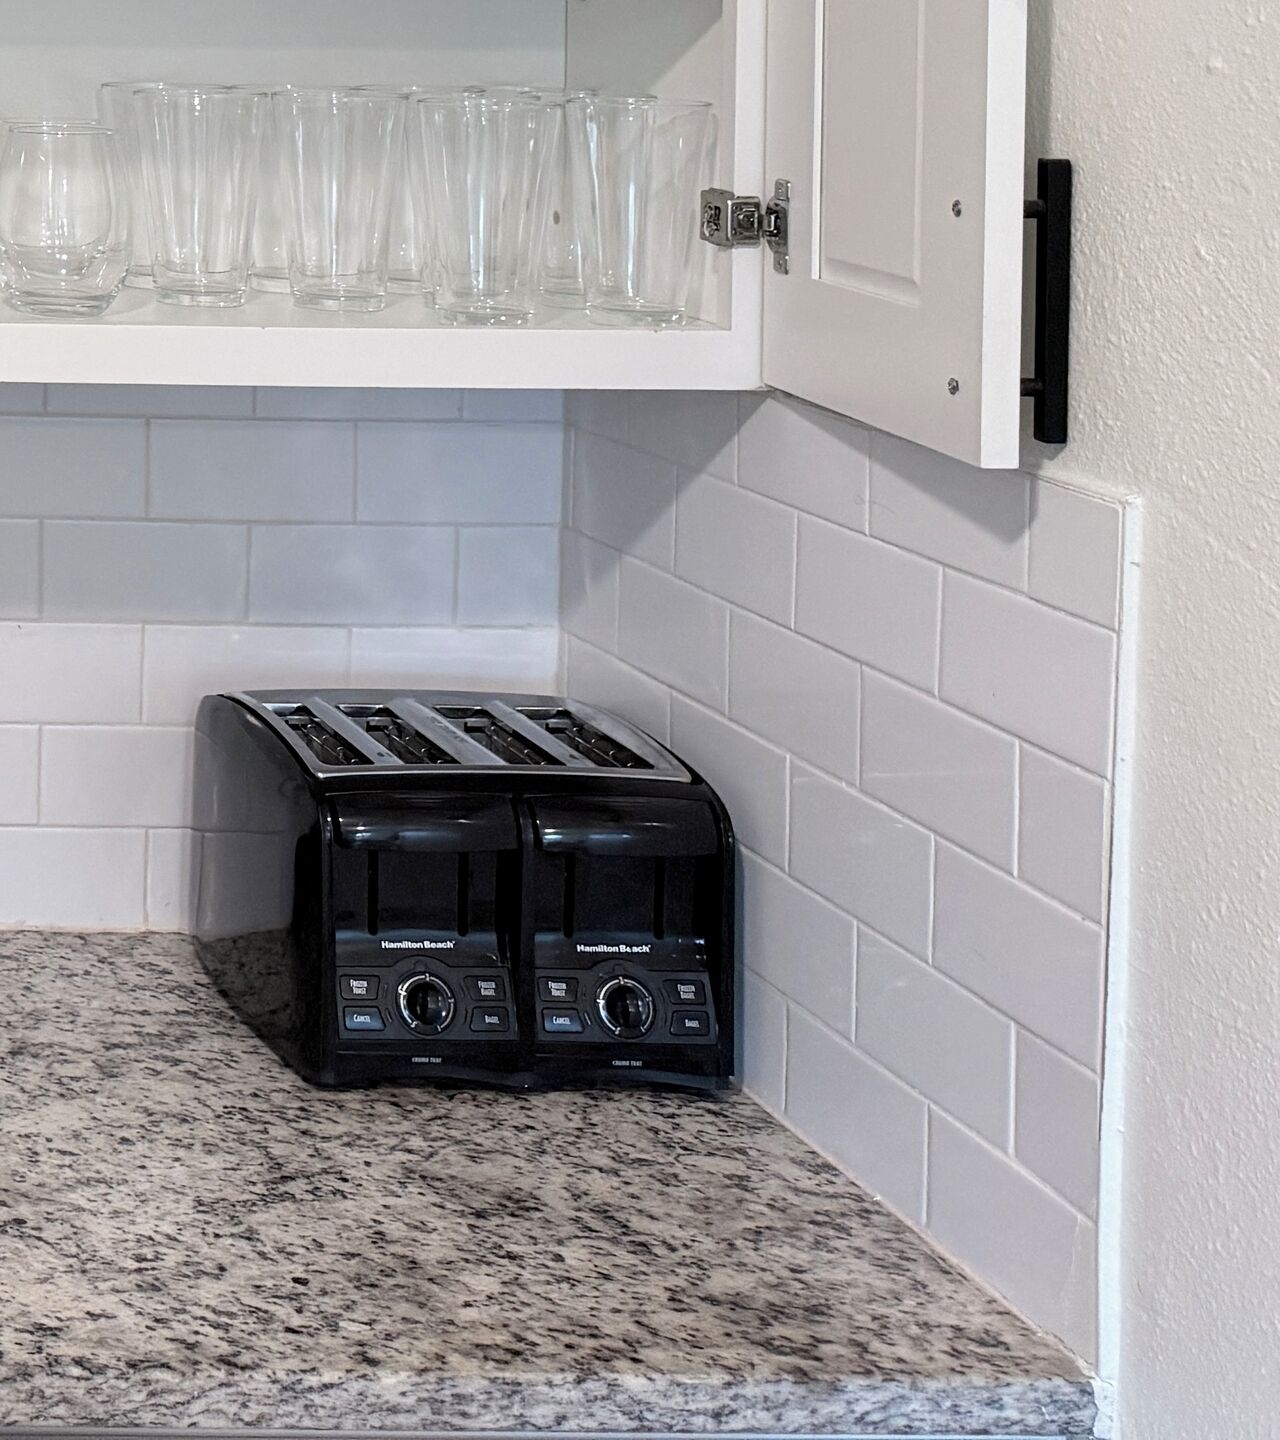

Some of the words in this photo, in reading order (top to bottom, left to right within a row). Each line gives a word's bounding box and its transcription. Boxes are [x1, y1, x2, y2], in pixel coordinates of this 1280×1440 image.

[381, 940, 423, 949] Hamilton
[424, 940, 453, 949] Beach
[576, 944, 618, 953] Hamilton
[619, 944, 650, 953] Beach
